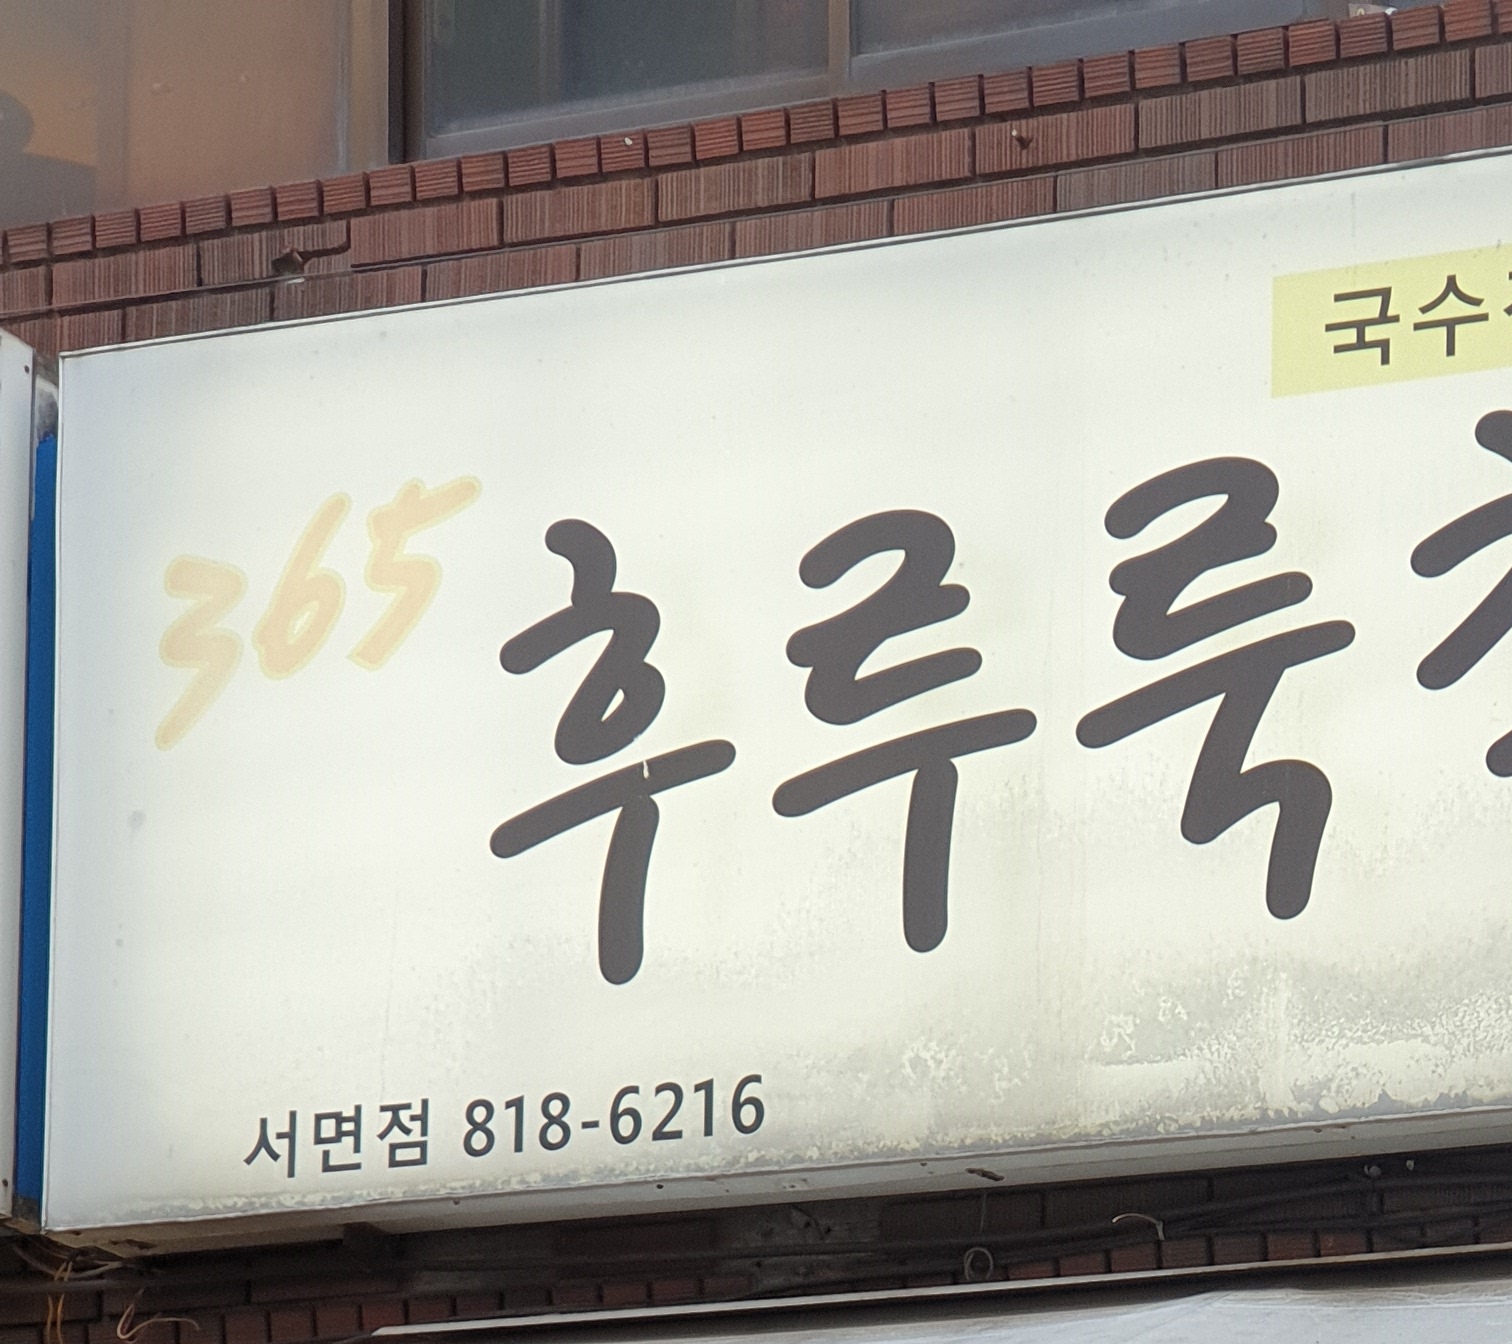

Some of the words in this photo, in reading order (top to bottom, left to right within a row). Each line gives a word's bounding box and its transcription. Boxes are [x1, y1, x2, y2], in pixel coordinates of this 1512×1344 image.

[155, 475, 482, 752] 365
[244, 1097, 432, 1178] 서면점
[464, 1075, 765, 1158] 818-6216
